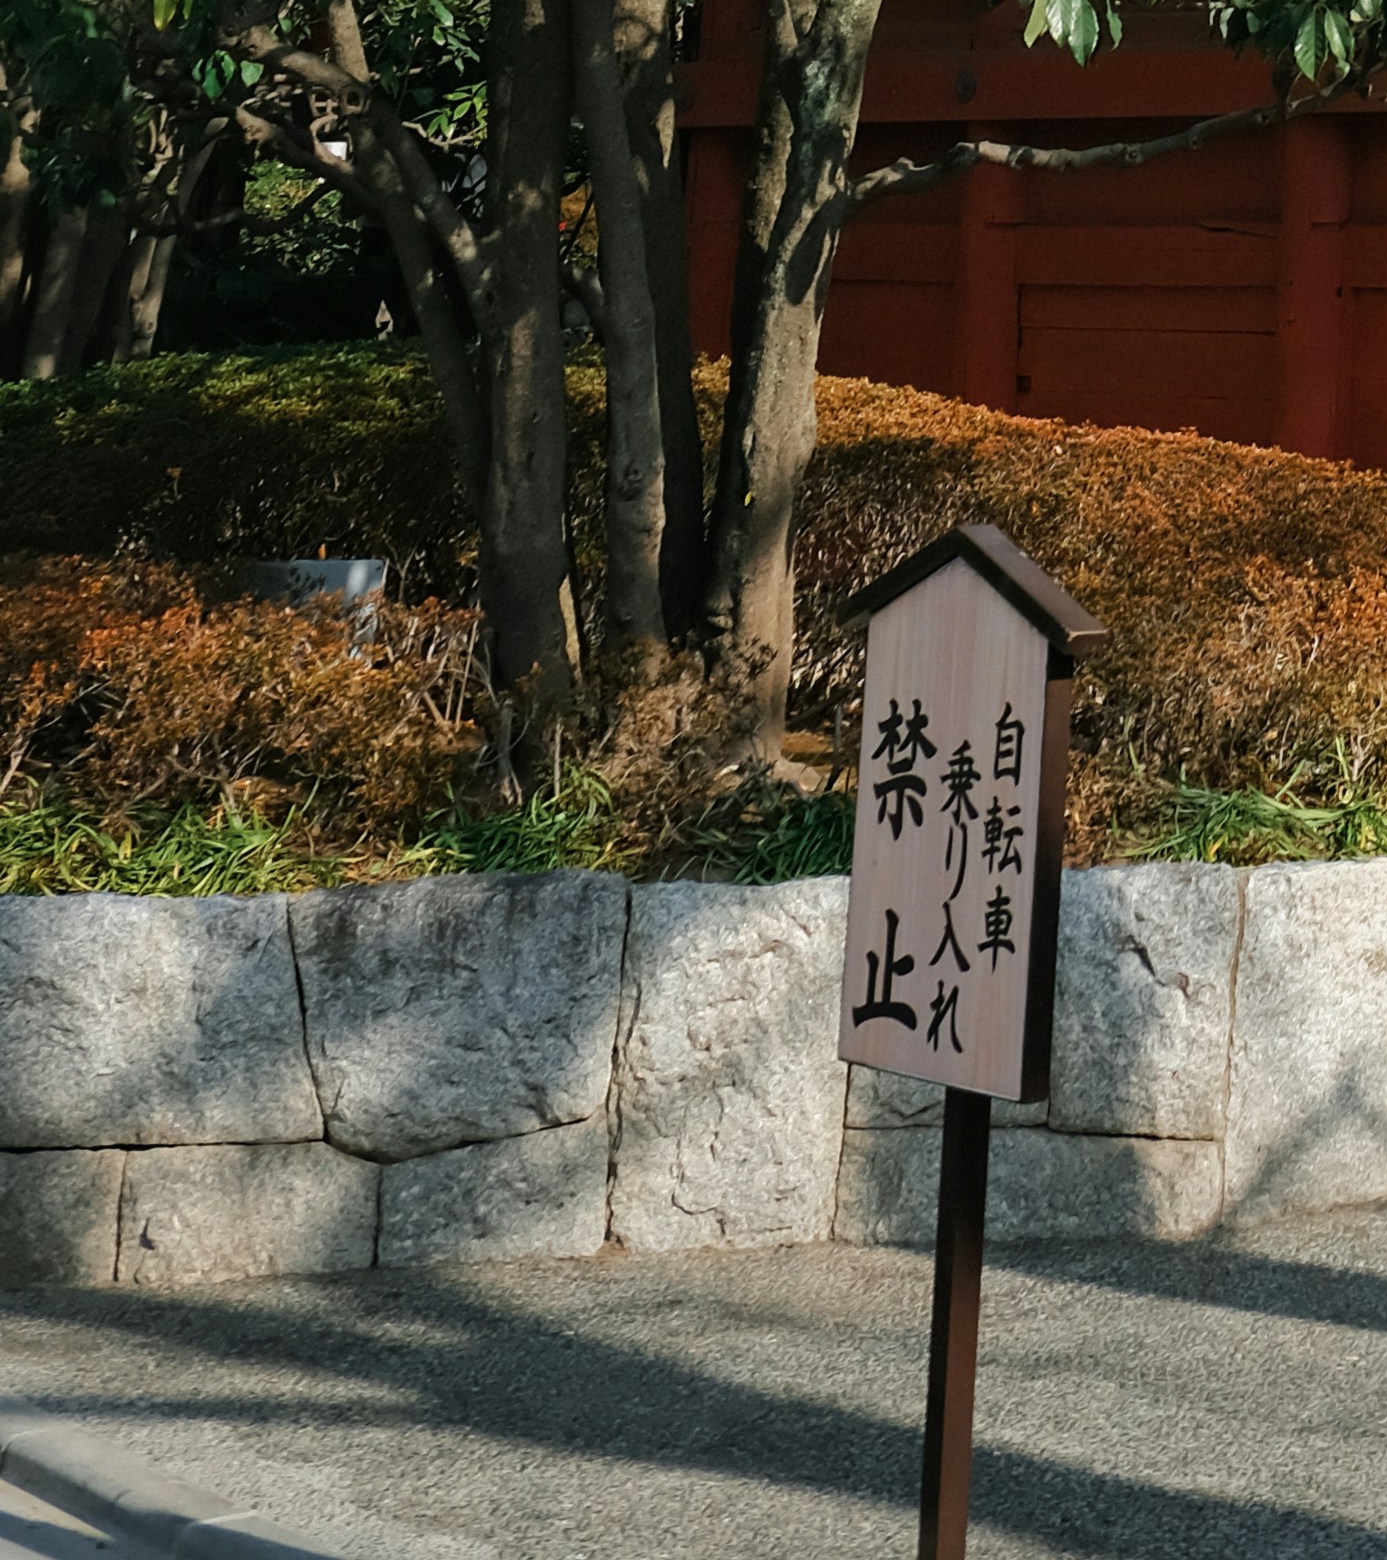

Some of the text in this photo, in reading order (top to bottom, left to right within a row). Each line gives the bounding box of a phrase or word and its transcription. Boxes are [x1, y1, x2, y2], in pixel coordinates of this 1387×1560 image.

[851, 697, 939, 1032] 禁止
[926, 739, 982, 1055] 乗り入れ
[977, 700, 1026, 974] 自転車
